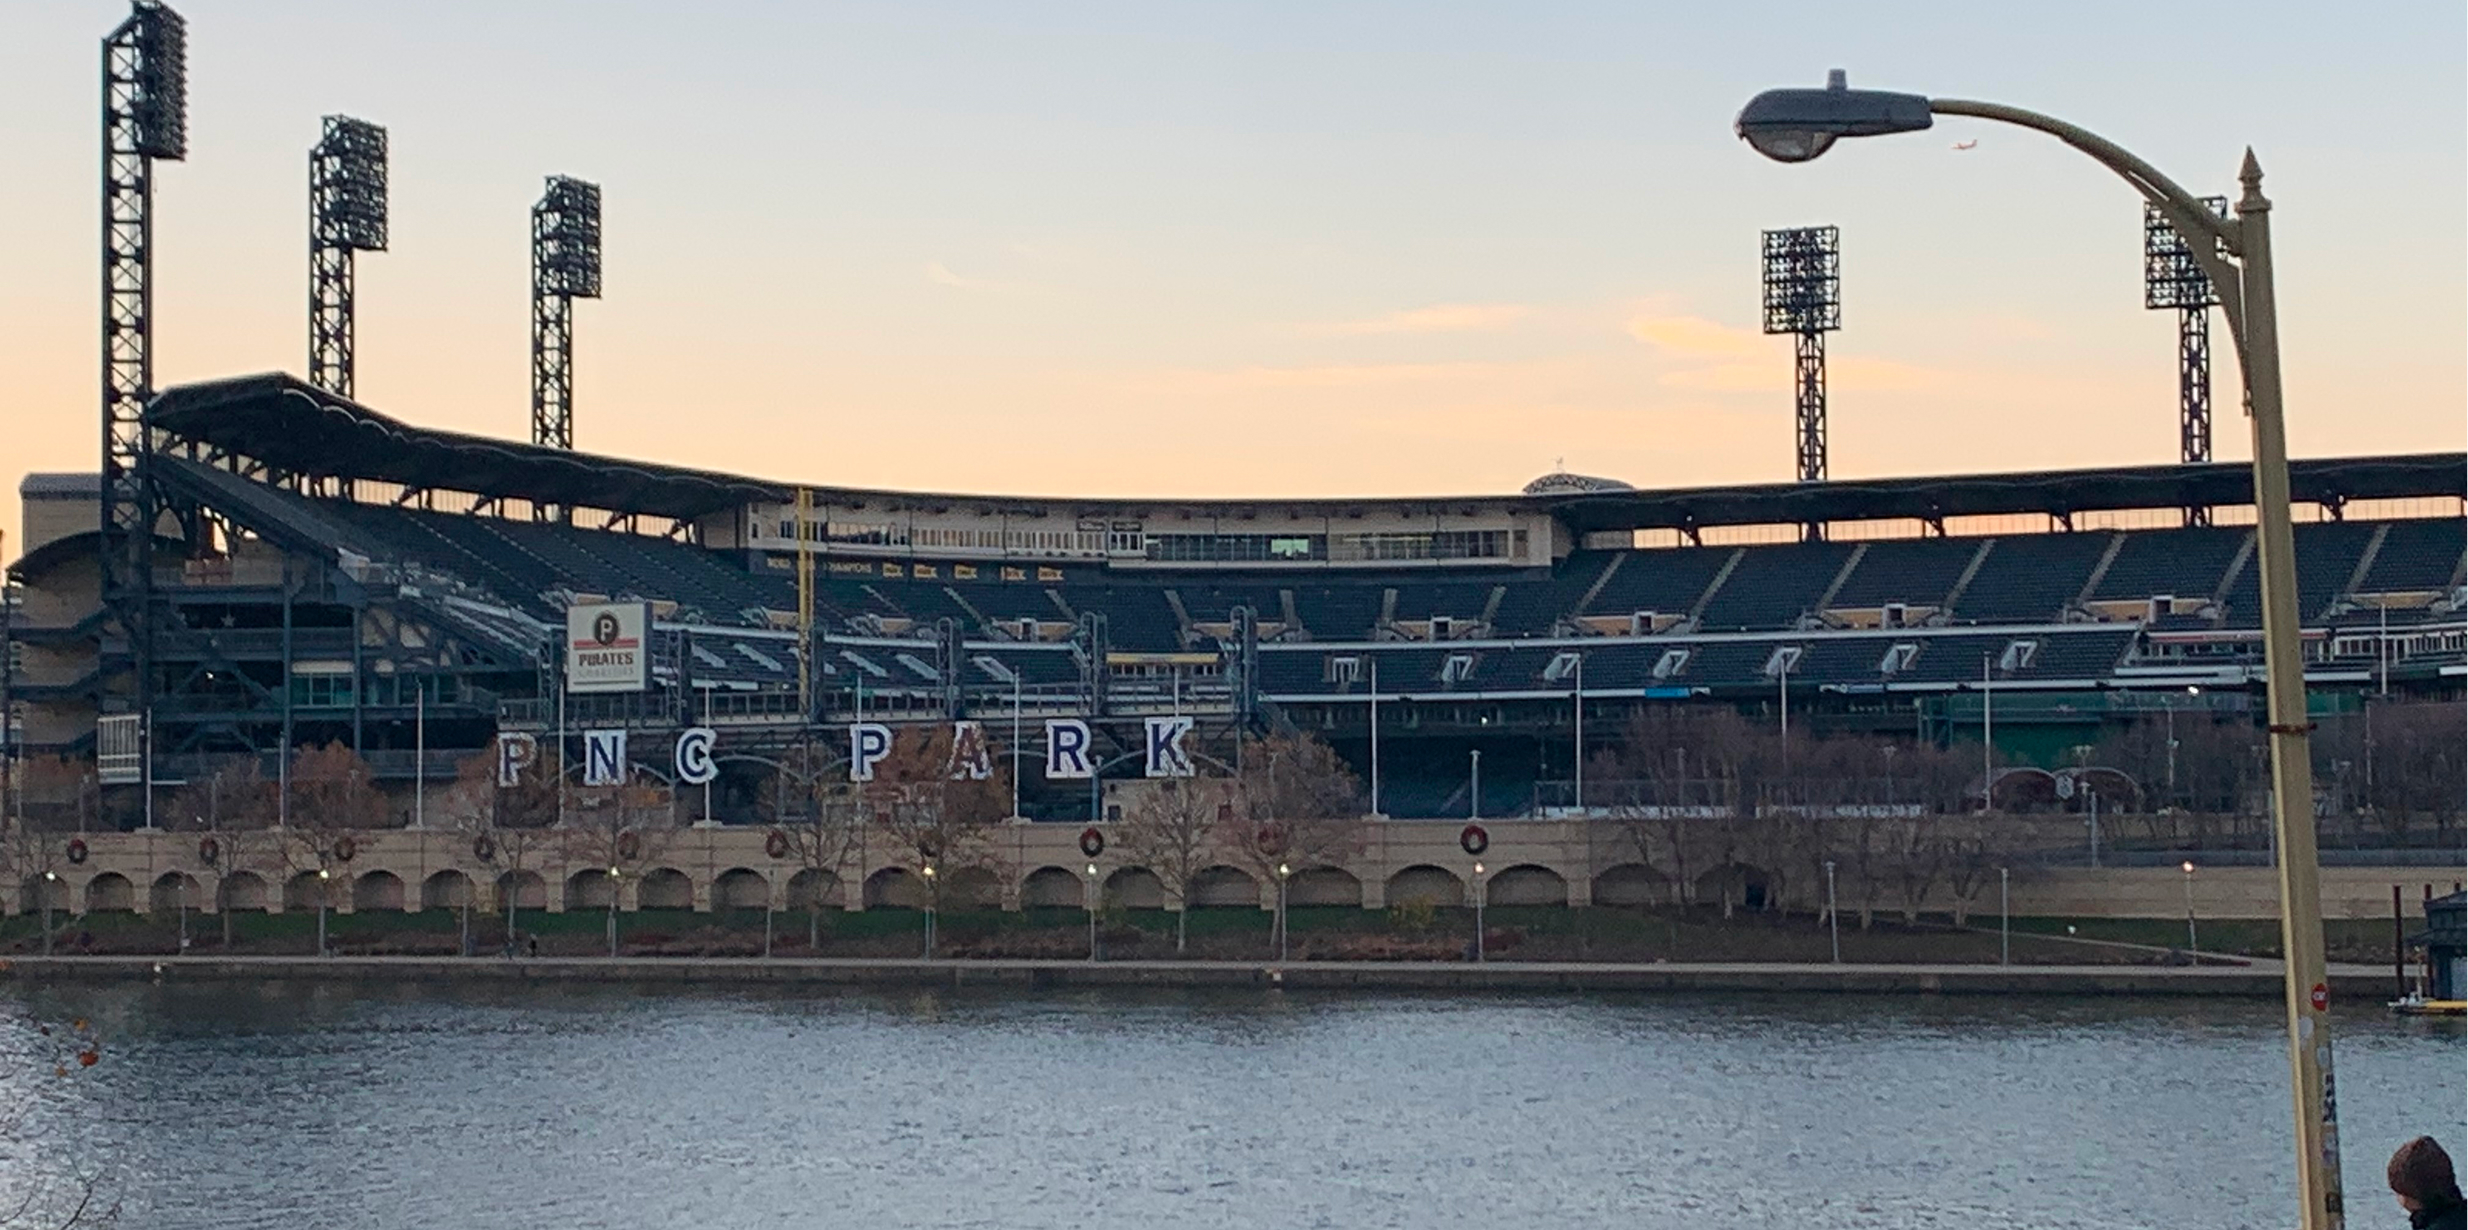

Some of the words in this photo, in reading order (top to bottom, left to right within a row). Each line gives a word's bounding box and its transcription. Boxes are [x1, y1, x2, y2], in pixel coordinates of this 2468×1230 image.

[578, 652, 634, 667] PIRATES
[497, 728, 719, 787] PNC
[850, 717, 1196, 782] PARK
